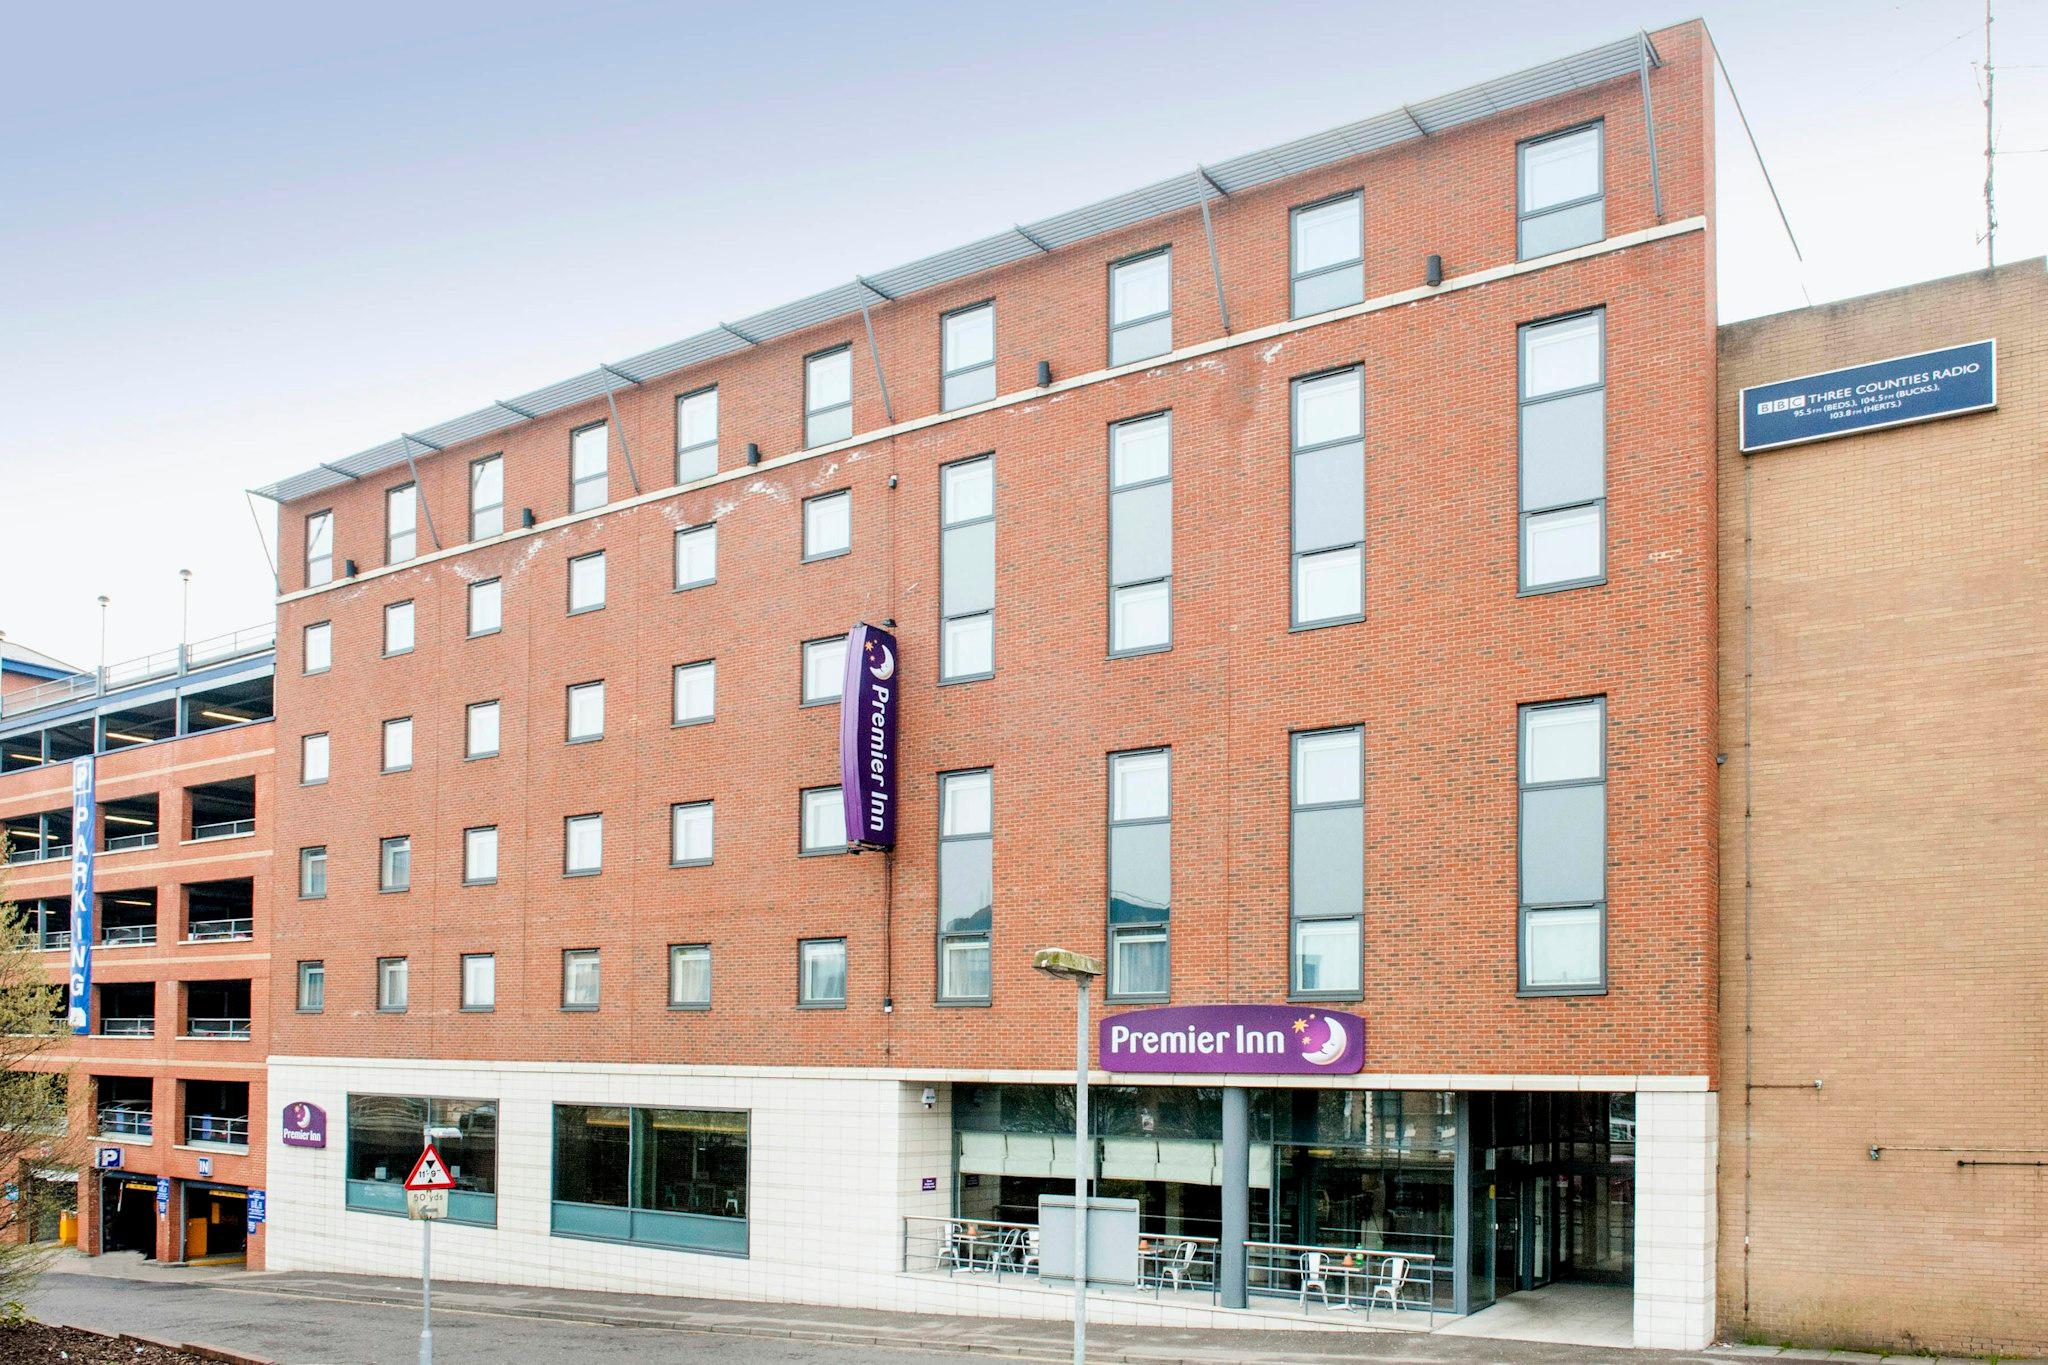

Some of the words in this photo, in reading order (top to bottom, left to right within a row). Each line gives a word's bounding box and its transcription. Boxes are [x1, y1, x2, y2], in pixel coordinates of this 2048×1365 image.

[1758, 395, 1805, 415] BBC
[1808, 387, 1852, 404] THREE
[1856, 372, 1930, 395] COUNTIES
[1932, 362, 1980, 380] RADIO
[870, 684, 889, 787] Premier
[870, 790, 889, 832] Inn
[71, 806, 89, 996] PARKING
[1111, 1024, 1230, 1054] Premier
[1236, 1025, 1285, 1054] Inn
[283, 1128, 310, 1140] Premier
[310, 1130, 322, 1142] Inn
[101, 1149, 119, 1167] P
[199, 1160, 209, 1174] IN
[413, 1193, 426, 1202] 50
[429, 1193, 443, 1202] yds
